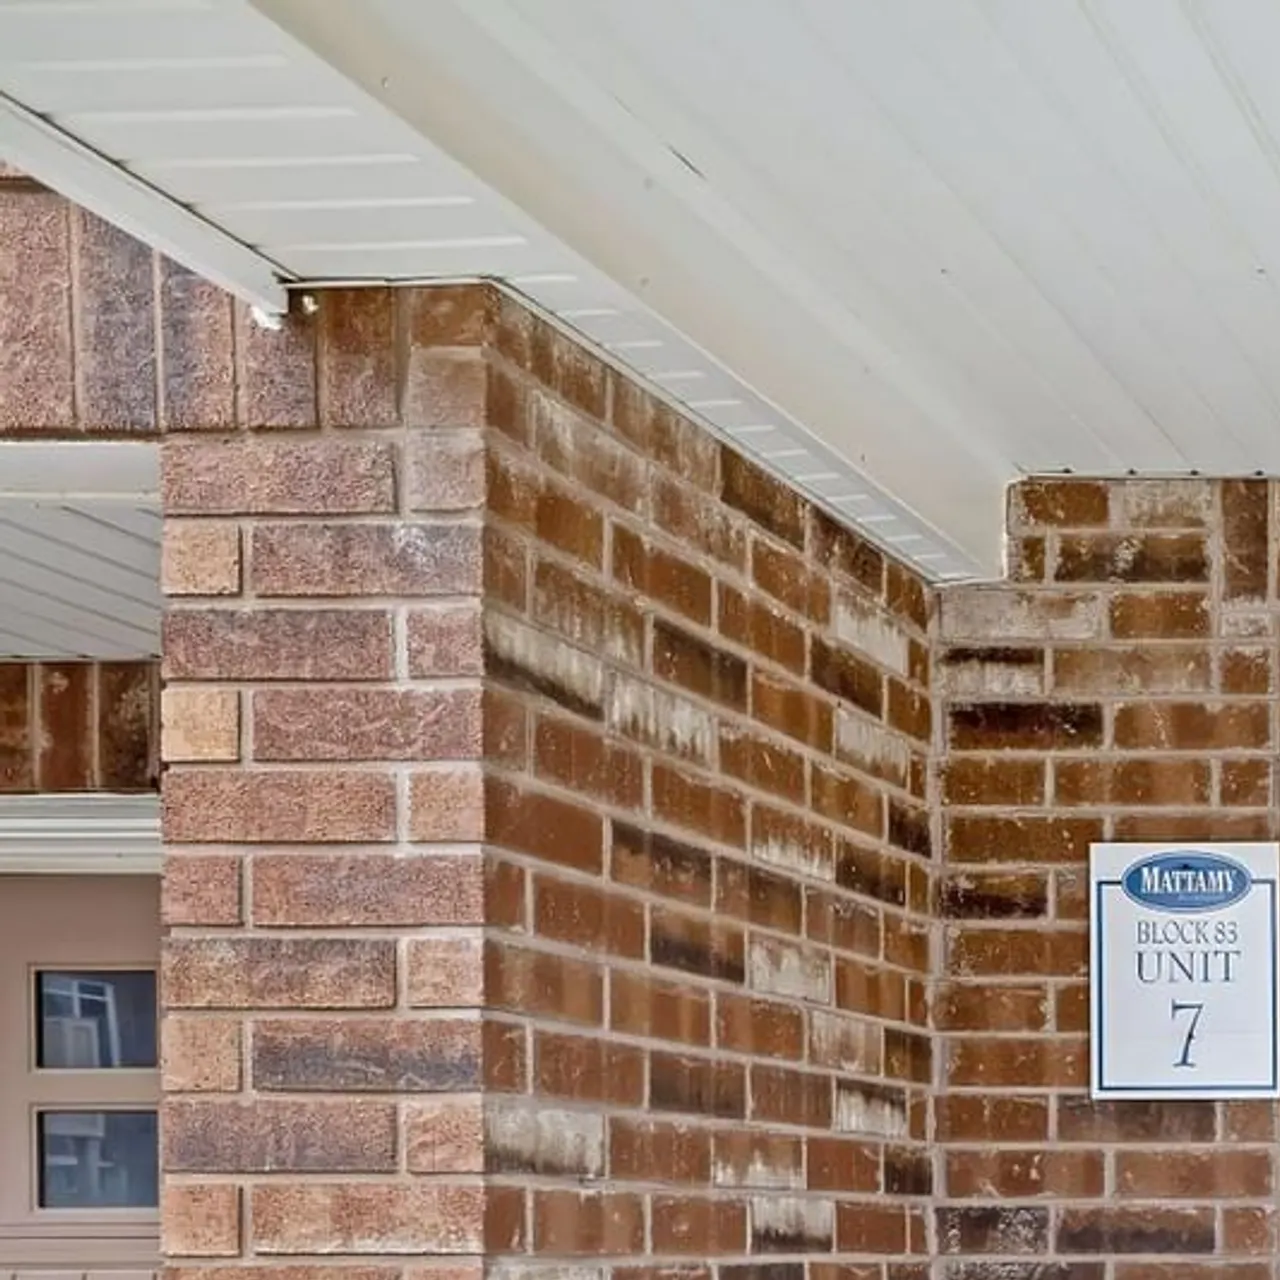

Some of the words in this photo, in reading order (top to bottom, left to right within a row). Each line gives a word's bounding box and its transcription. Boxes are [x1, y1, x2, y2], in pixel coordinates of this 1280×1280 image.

[1140, 865, 1237, 893] MATTAMY
[1136, 919, 1209, 945] BLOCK
[1213, 921, 1239, 945] 83
[1136, 950, 1241, 984] UNIT
[1170, 998, 1204, 1068] 7
